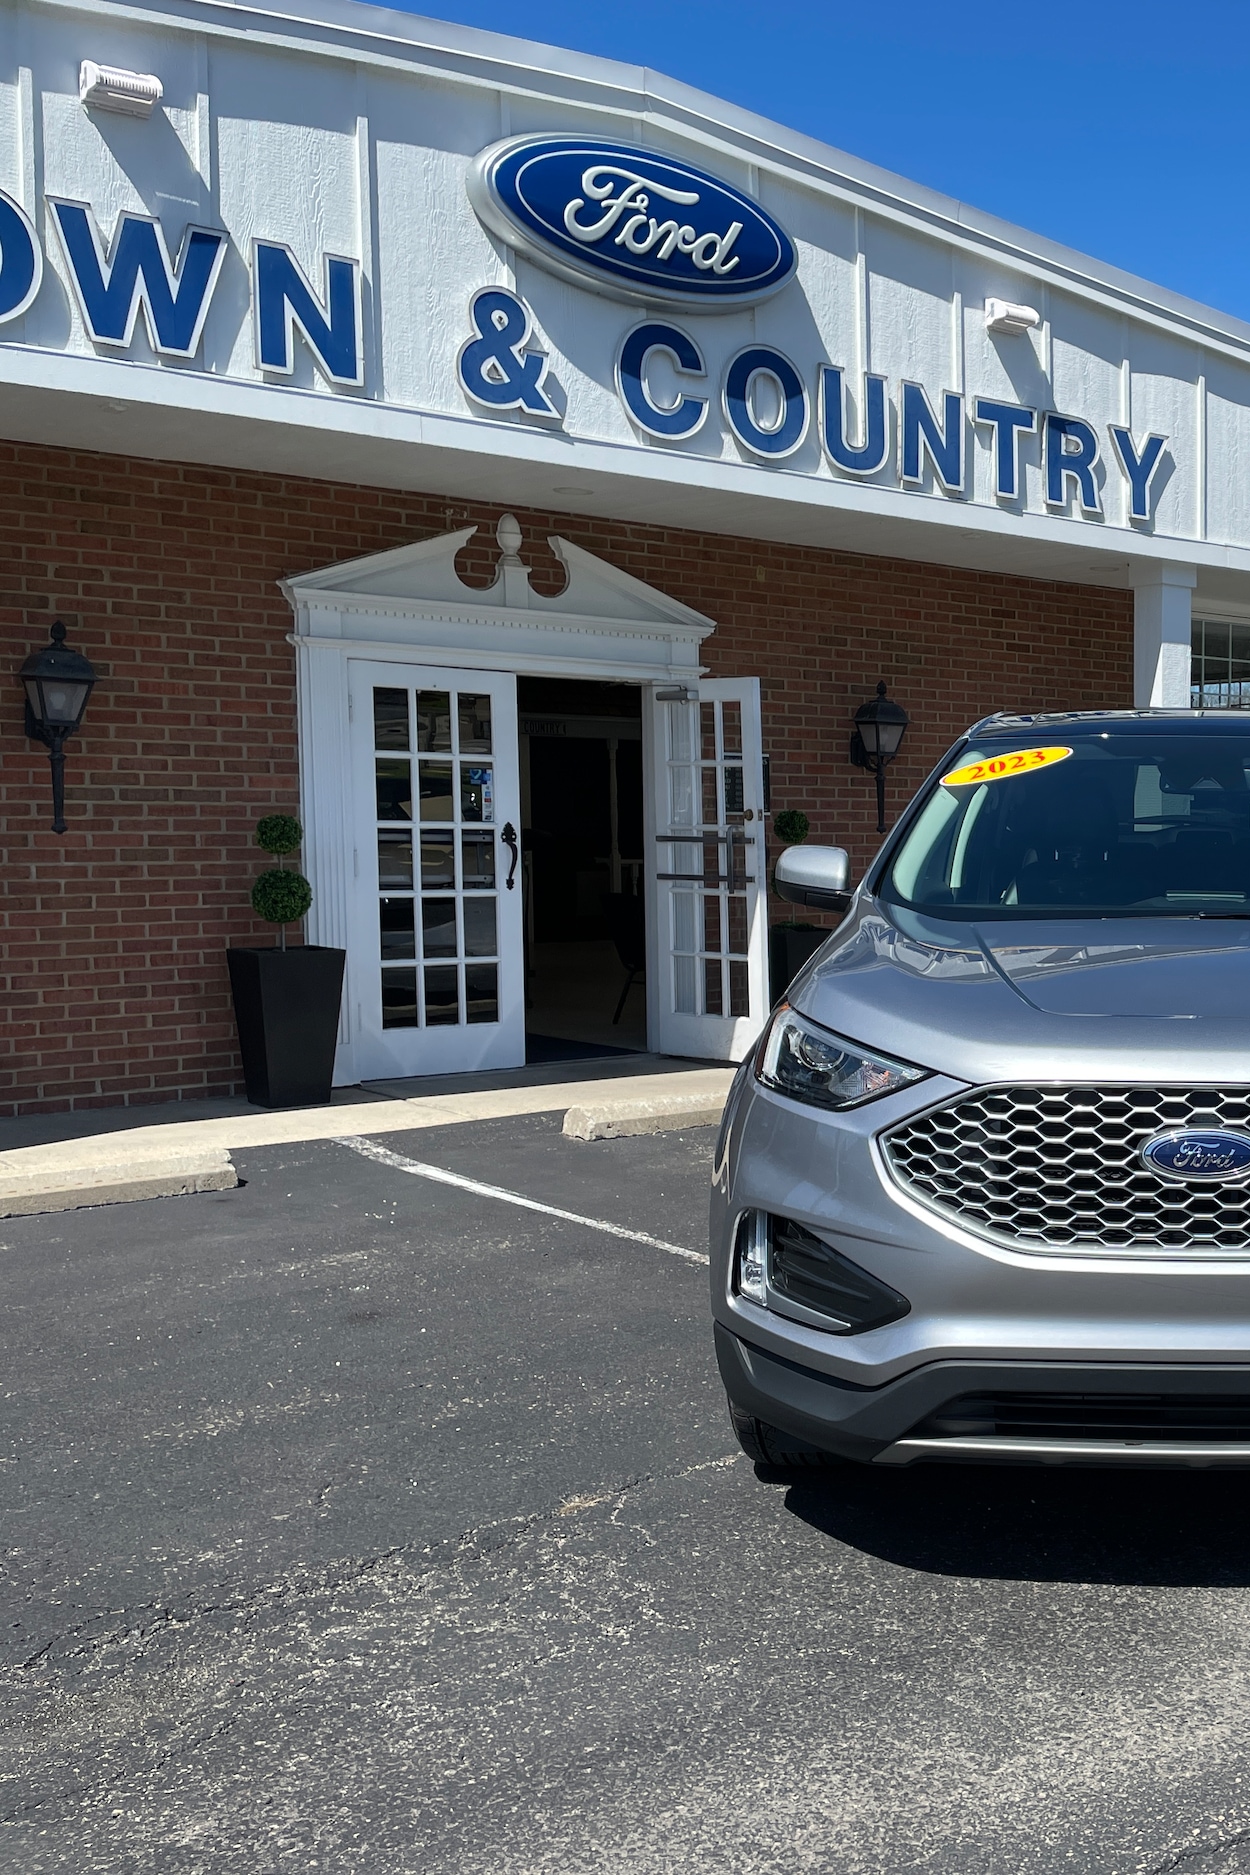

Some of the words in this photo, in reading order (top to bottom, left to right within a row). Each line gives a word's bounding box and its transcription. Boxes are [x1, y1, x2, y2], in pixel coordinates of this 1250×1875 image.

[563, 165, 743, 275] Ford
[456, 285, 562, 420] &
[614, 318, 1170, 521] COUNTRY
[523, 720, 560, 734] COUNTRY
[968, 751, 1046, 780] 2023
[1172, 1141, 1236, 1168] Ford
